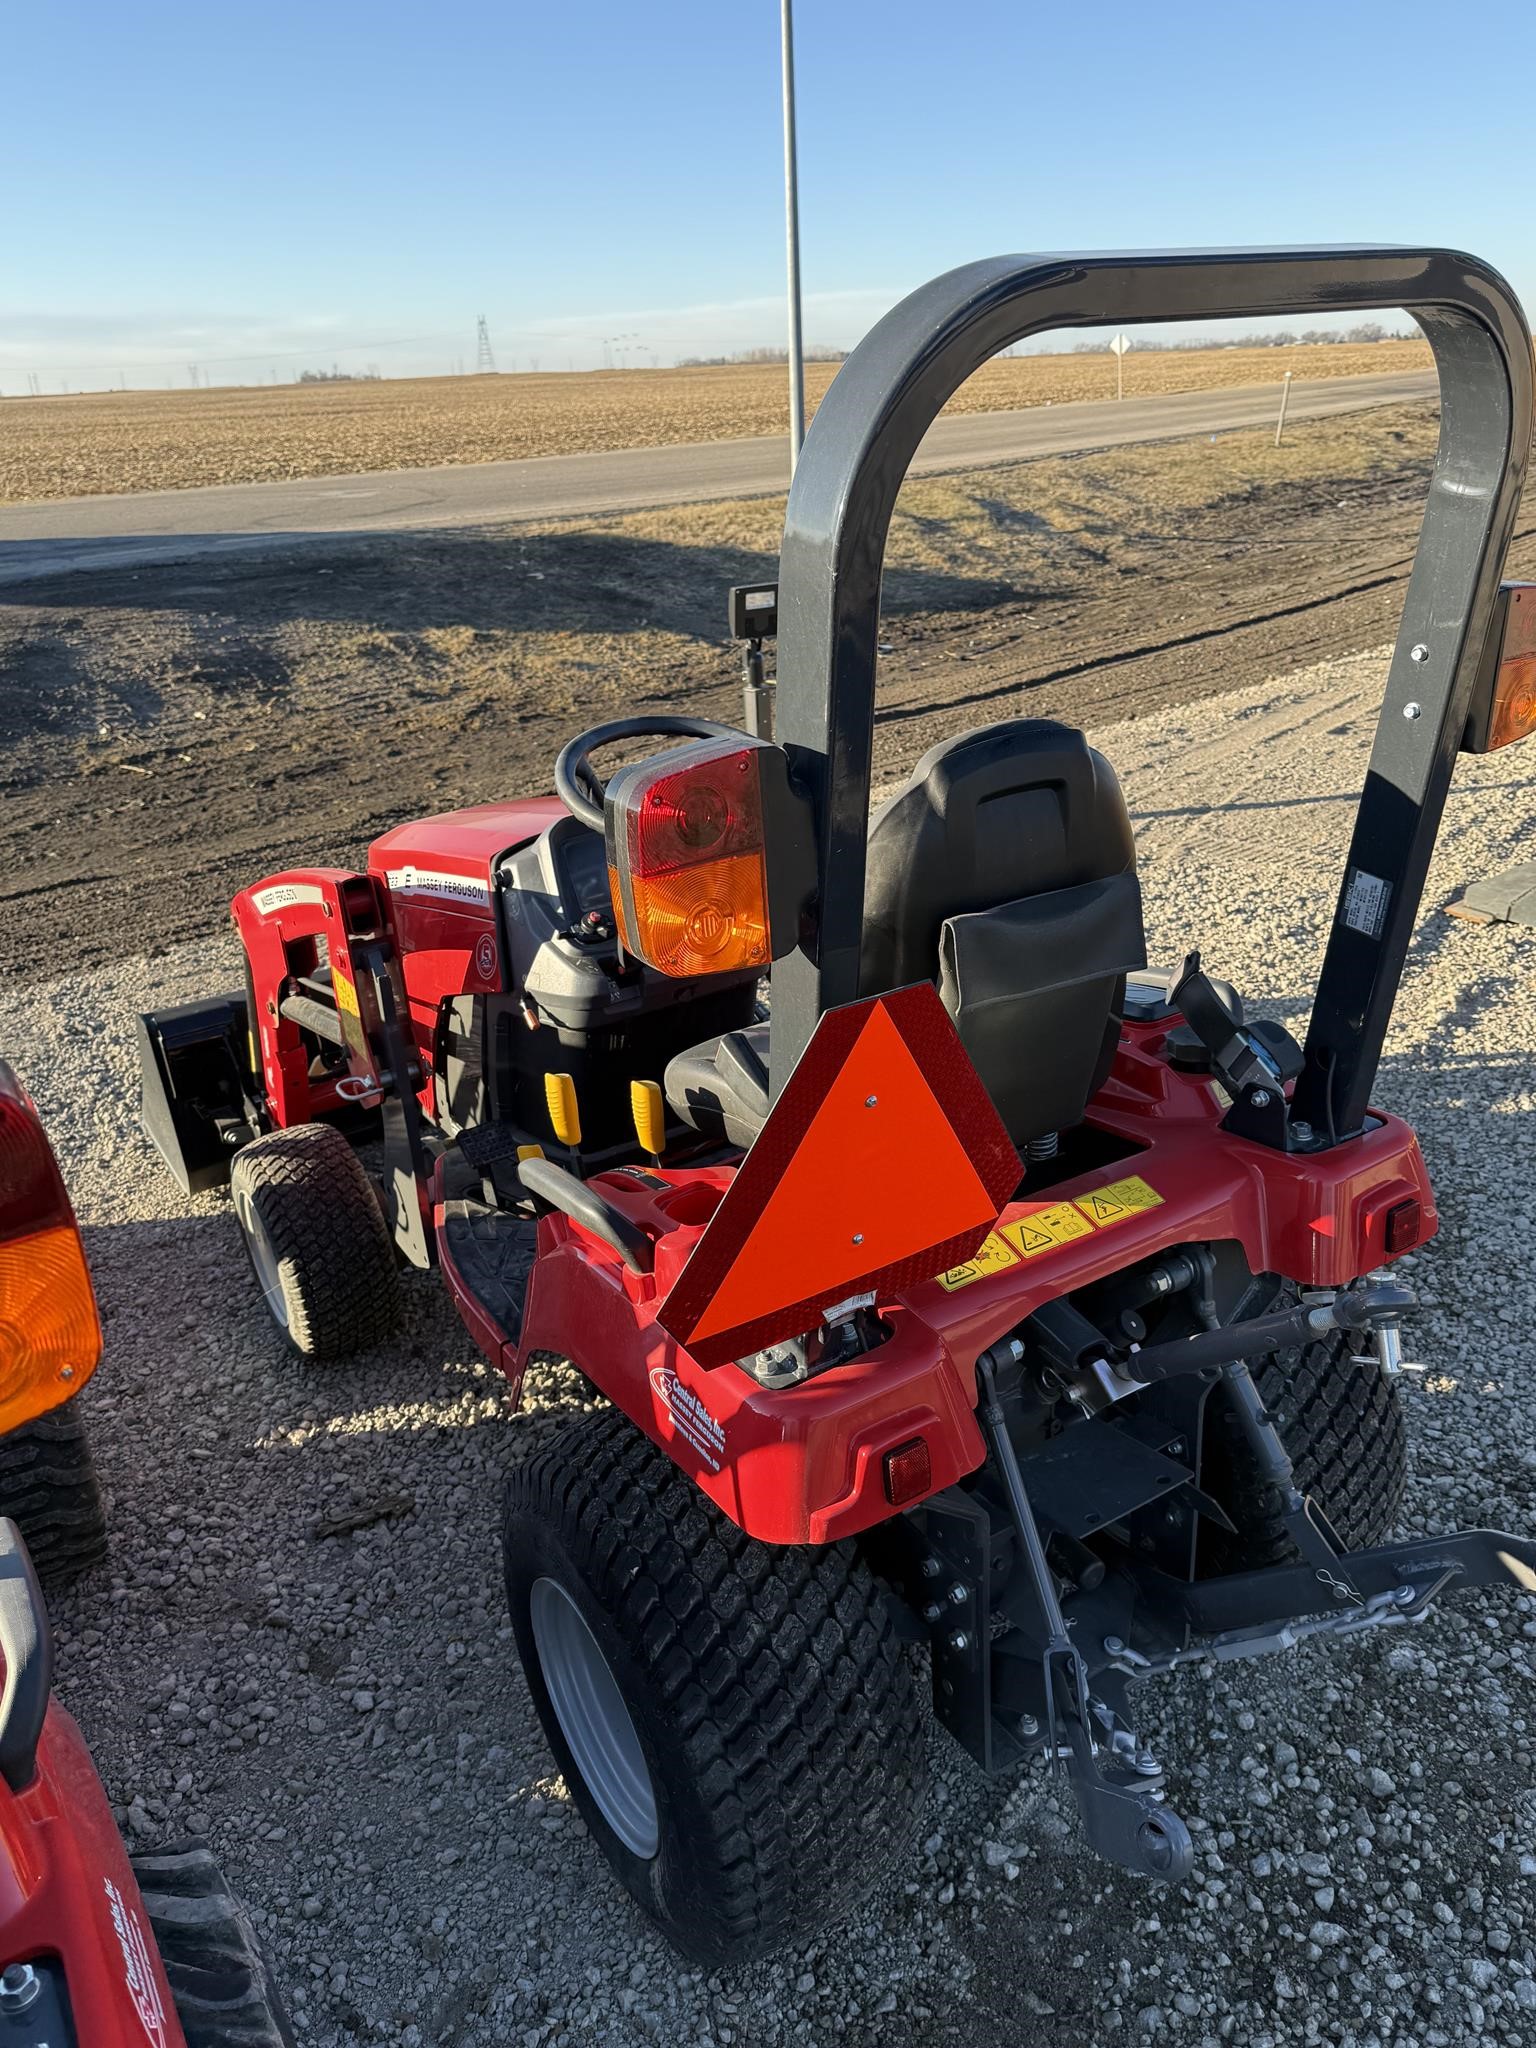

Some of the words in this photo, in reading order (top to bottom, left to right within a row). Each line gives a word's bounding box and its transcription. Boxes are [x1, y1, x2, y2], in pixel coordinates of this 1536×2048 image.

[417, 877, 442, 892] MASSEY
[444, 881, 484, 900] FERGUSON
[673, 1377, 696, 1411] Central
[695, 1401, 713, 1431] Sales,
[713, 1418, 726, 1443] Inc.
